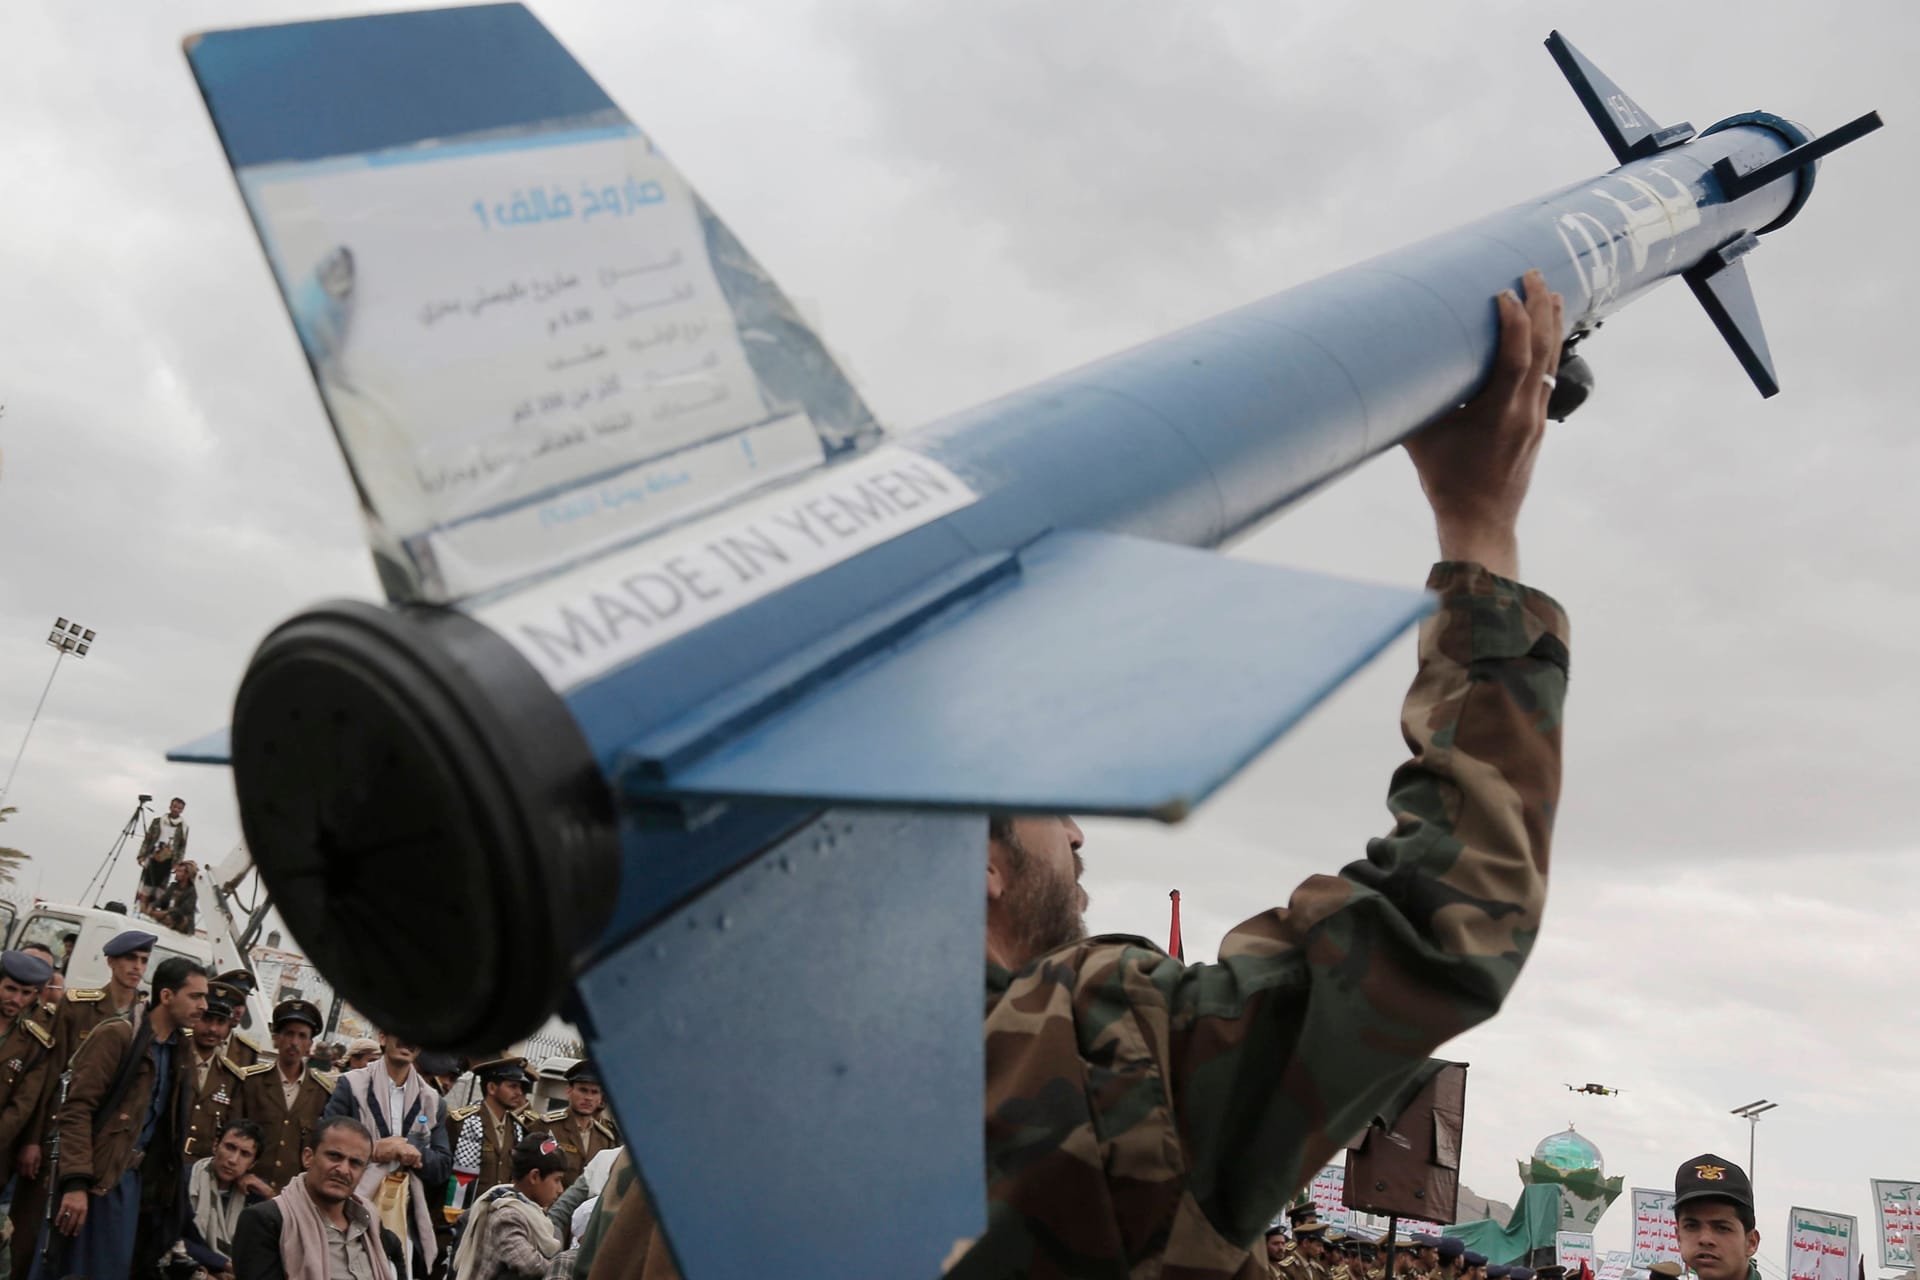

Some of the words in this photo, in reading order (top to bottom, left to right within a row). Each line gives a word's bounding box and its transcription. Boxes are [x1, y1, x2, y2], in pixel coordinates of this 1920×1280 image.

[581, 175, 666, 222] صاروخ
[519, 556, 723, 669] MADE
[707, 524, 791, 583] IN
[773, 462, 951, 550] YEMEN
[1794, 1216, 1848, 1238] قاطعوا
